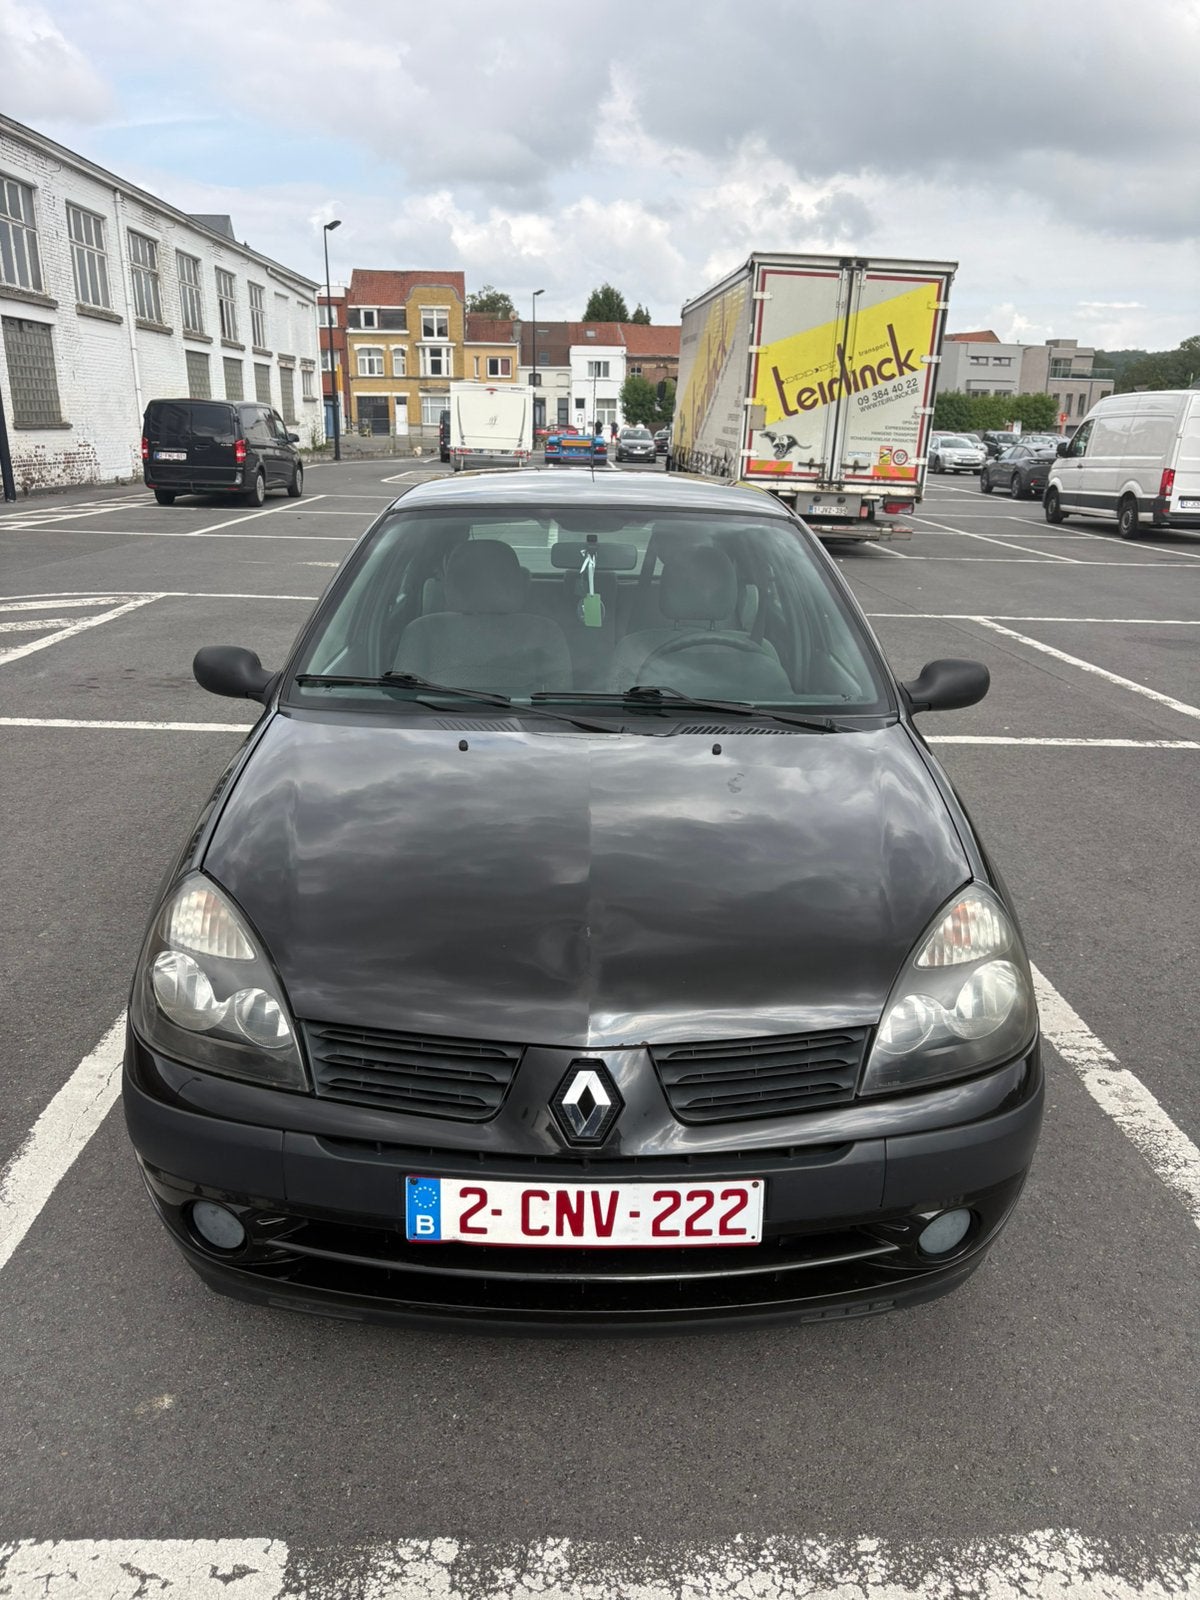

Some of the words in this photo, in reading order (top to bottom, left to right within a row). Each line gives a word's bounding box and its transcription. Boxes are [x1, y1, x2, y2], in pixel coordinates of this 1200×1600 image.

[858, 341, 890, 357] transport
[857, 395, 869, 406] 09
[872, 388, 889, 401] 384
[892, 383, 904, 393] 40
[906, 378, 918, 389] 22
[416, 1215, 435, 1235] B
